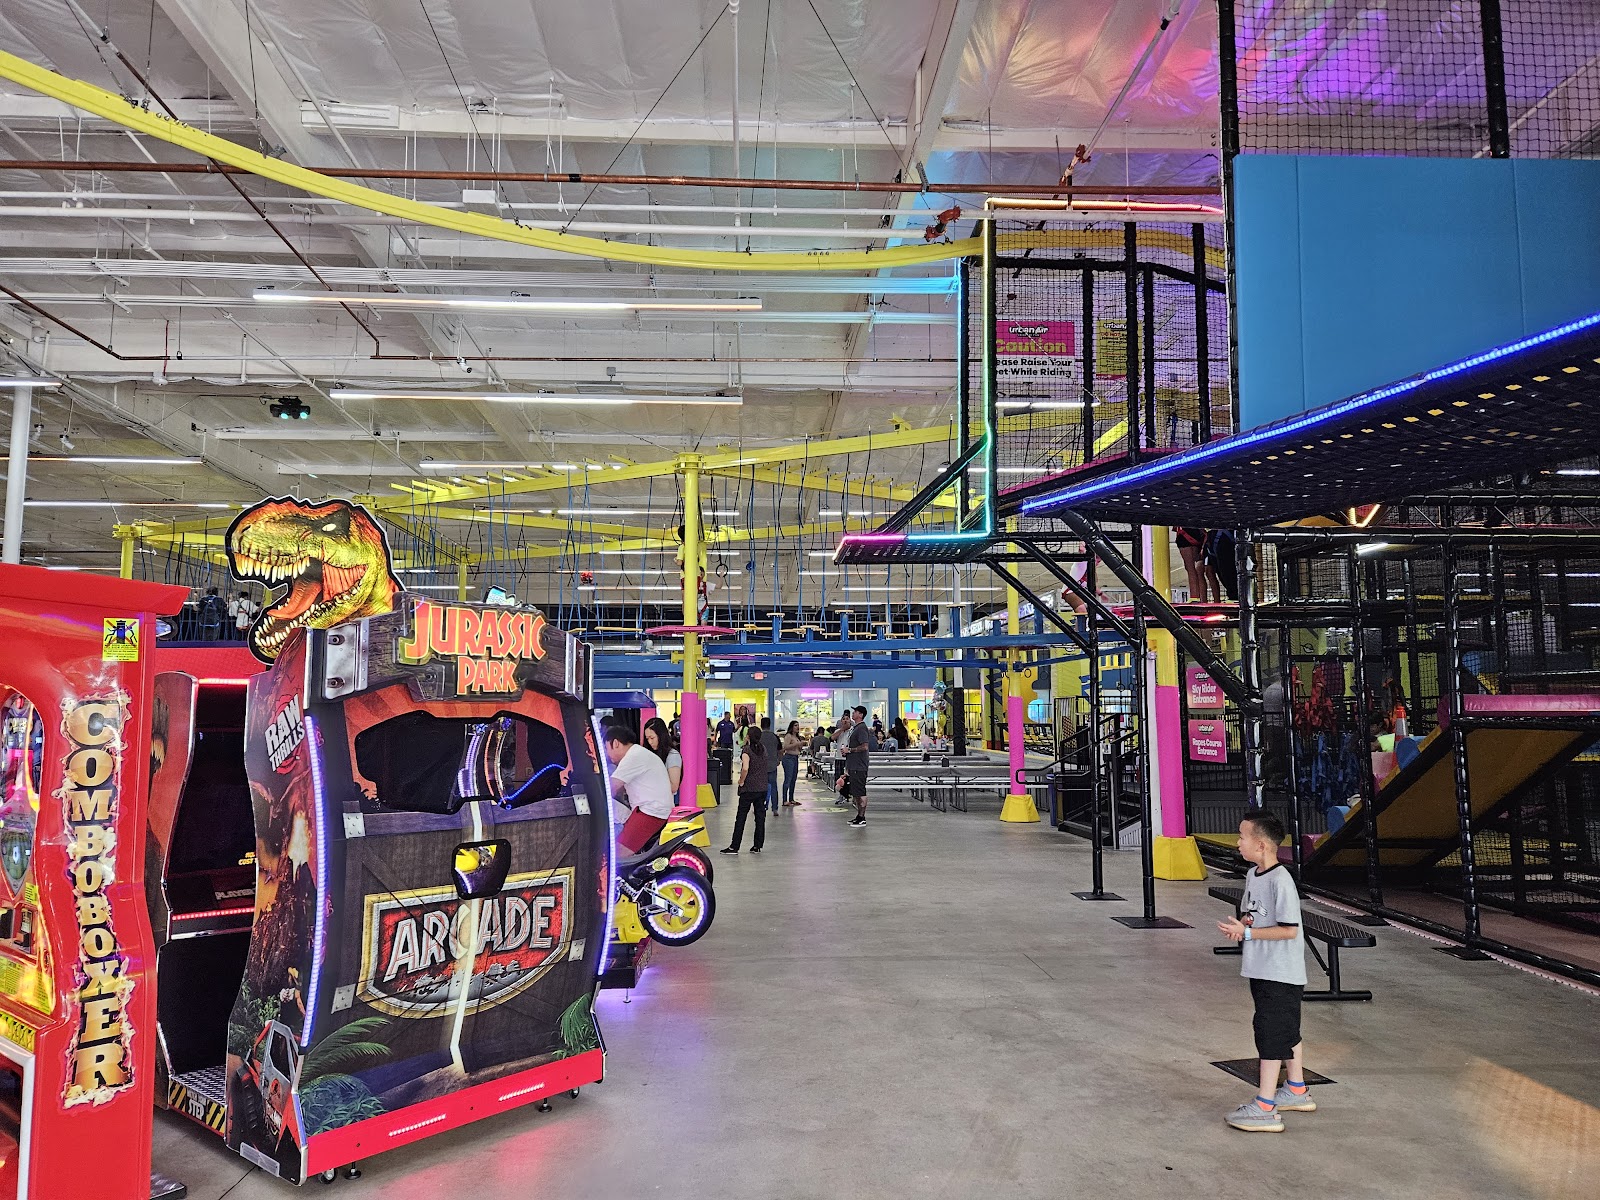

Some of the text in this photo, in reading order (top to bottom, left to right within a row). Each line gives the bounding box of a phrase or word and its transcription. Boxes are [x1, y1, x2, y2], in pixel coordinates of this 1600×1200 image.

[996, 337, 1067, 353] Caution
[996, 357, 1073, 367] ease Raise Your
[1011, 367, 1040, 376] While
[1040, 367, 1072, 378] Riding
[399, 599, 547, 662] JURASSIC
[455, 654, 518, 695] PARK
[1192, 684, 1216, 695] Sky Rider
[1193, 695, 1216, 704] Entrance
[265, 693, 301, 755] RAW
[269, 721, 306, 772] THRILLS
[1197, 747, 1218, 757] Entrance
[1206, 739, 1222, 748] Course
[70, 703, 131, 1089] COMBOBOXER
[382, 895, 556, 984] ARCADE
[188, 1098, 205, 1121] STEP
